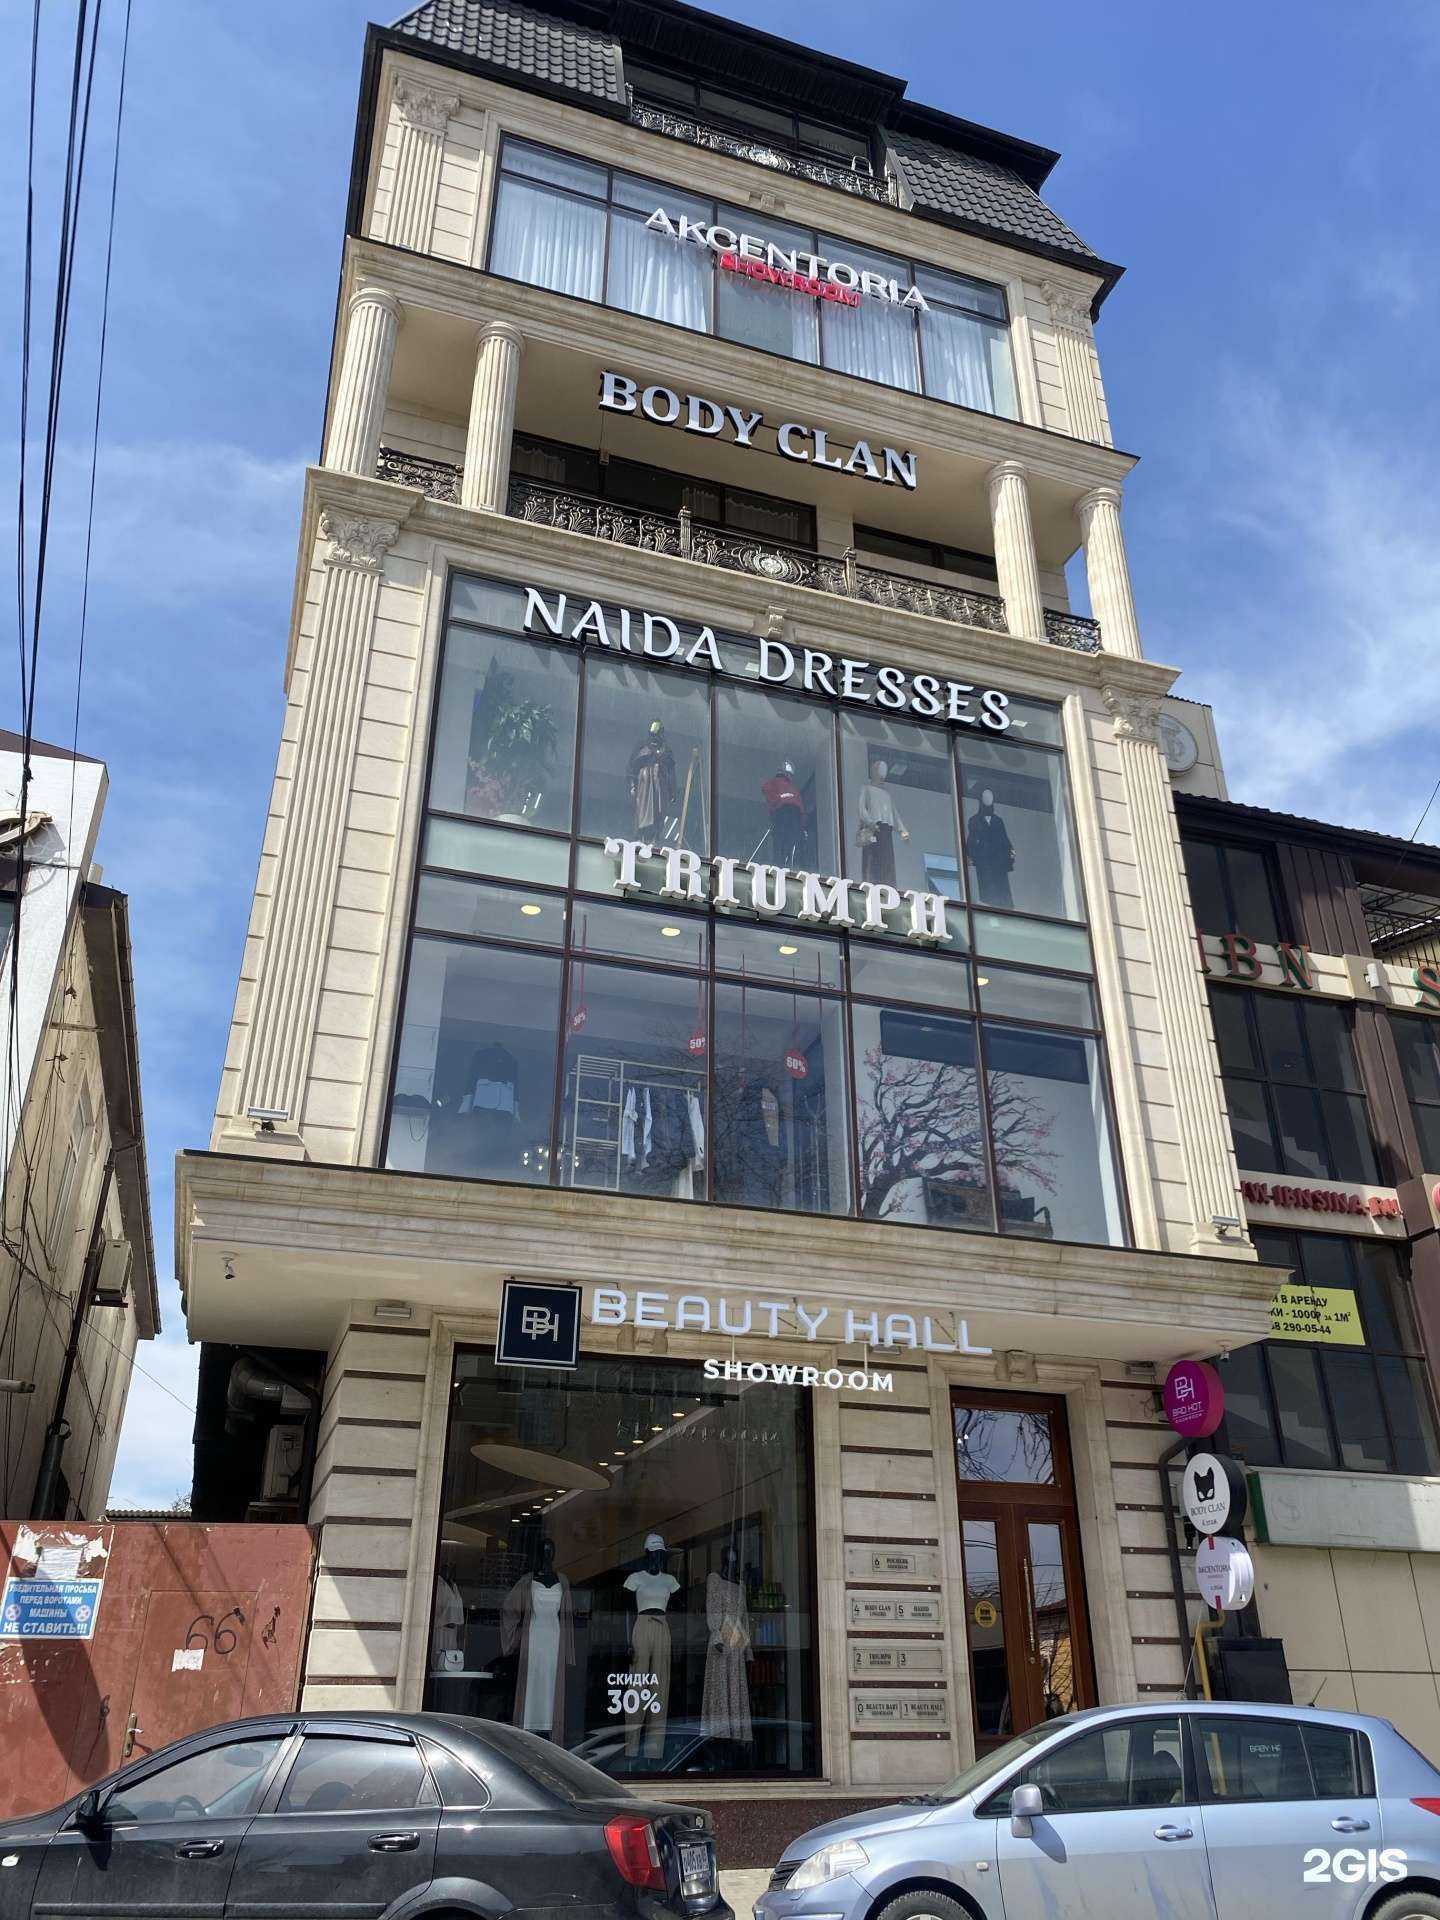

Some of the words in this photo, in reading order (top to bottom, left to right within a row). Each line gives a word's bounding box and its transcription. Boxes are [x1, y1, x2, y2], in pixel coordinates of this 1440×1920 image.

[645, 207, 930, 311] AKCENTORIA
[599, 370, 763, 446] BODY
[776, 422, 918, 491] CLAN
[523, 586, 723, 671] NAIDA
[757, 636, 1012, 733] DRESSES
[604, 836, 954, 944] TRIUMPH
[1290, 1295, 1328, 1308] АРЕНДУ
[591, 1288, 829, 1341] BEAUTY
[845, 1308, 994, 1354] HALL
[1283, 1322, 1332, 1335] 290-05-44
[703, 1357, 894, 1393] SHOWROOM
[64, 1584, 97, 1594] ПРОСЬБА
[20, 1595, 44, 1605] ПЕРЕД
[44, 1596, 83, 1606] ВОРОТАМИ
[29, 1607, 68, 1618] МАШИНЫ
[3, 1622, 20, 1633] НЕ
[22, 1622, 88, 1634] СТАВИТЬ!!!
[607, 1673, 659, 1687] СКИДКА
[607, 1688, 661, 1715] 30%
